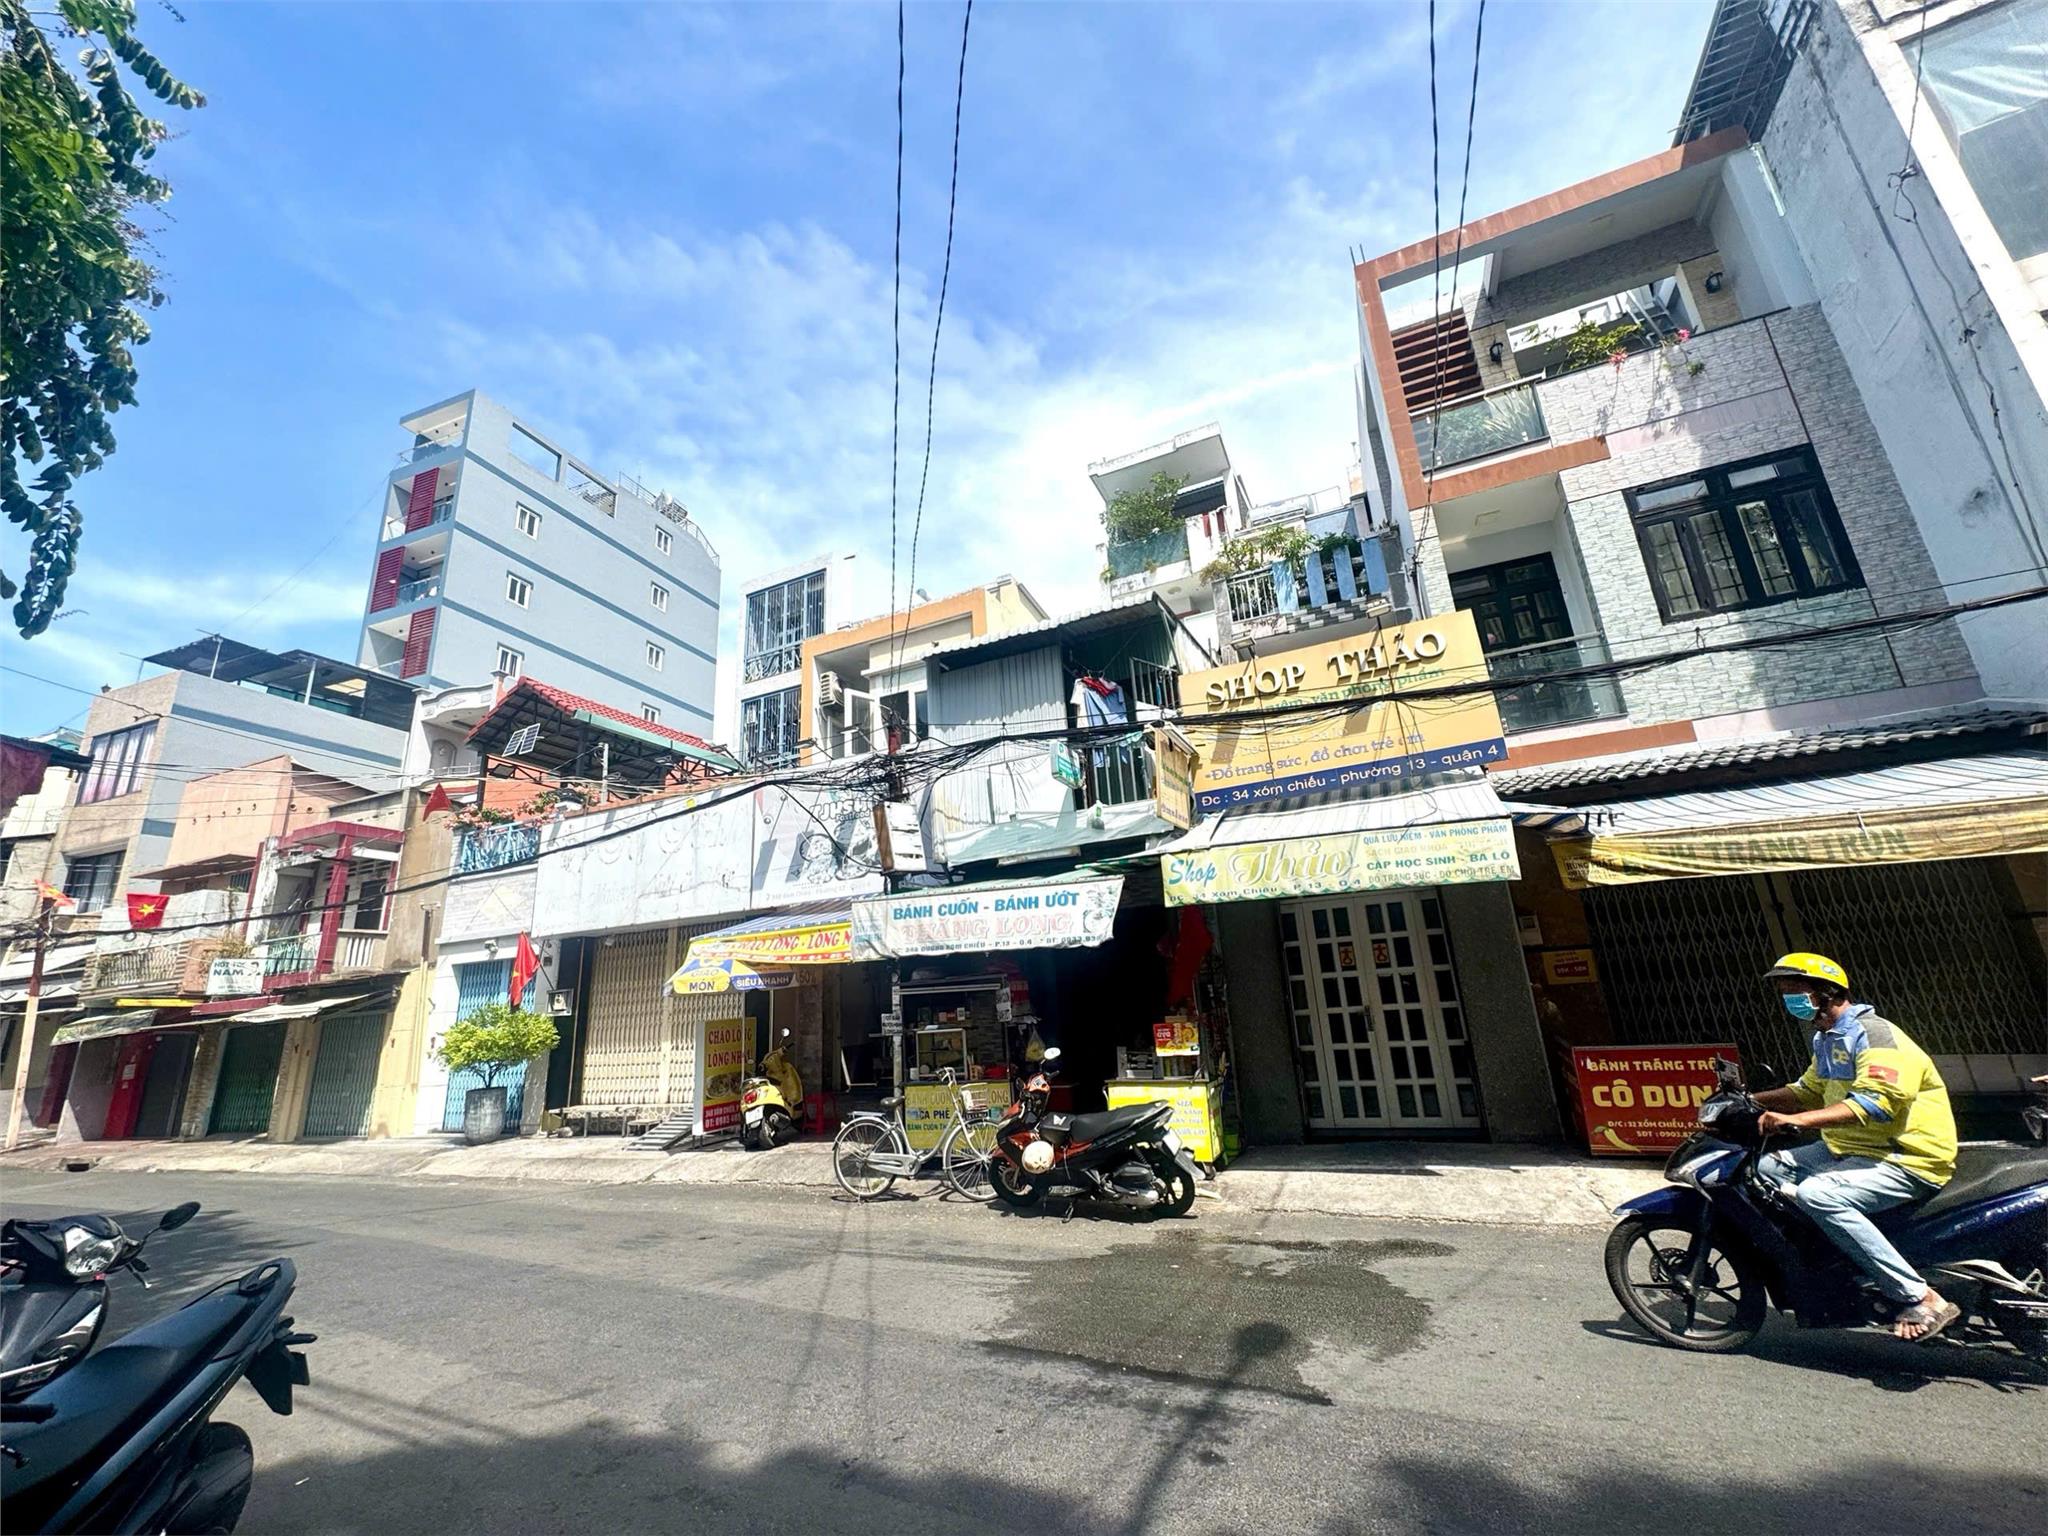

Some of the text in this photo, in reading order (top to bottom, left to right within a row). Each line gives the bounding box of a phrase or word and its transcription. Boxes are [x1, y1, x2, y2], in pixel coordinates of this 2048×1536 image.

[1206, 631, 1447, 706] SHOP THẢO
[1201, 795, 1221, 807] Đc
[1232, 790, 1250, 802] 34
[1253, 783, 1284, 798] xóm
[1288, 775, 1326, 792] chiếu
[1340, 763, 1401, 785] phường
[1406, 758, 1426, 771] 13
[1441, 748, 1483, 767] quận
[1487, 744, 1498, 756] 4
[1235, 761, 1274, 776] trang
[1168, 838, 1359, 887] Shop Thảo
[1395, 857, 1422, 869] HỌC
[1425, 854, 1456, 866] SINH
[1470, 853, 1489, 863] BA
[893, 903, 933, 920] BÁNH
[937, 897, 979, 917] CUỐN
[994, 894, 1040, 912] BÁNH
[1045, 889, 1080, 908] ƯỚT
[995, 913, 1075, 938] LONG
[807, 928, 841, 949] LÒNG
[213, 968, 244, 976] NAM
[689, 979, 715, 992] MÓN
[707, 1049, 730, 1068] LÒNG
[1589, 1058, 1630, 1072] BÁNH
[1633, 1057, 1685, 1071] TRÁNG
[1592, 1078, 1714, 1108] CÔ DUN
